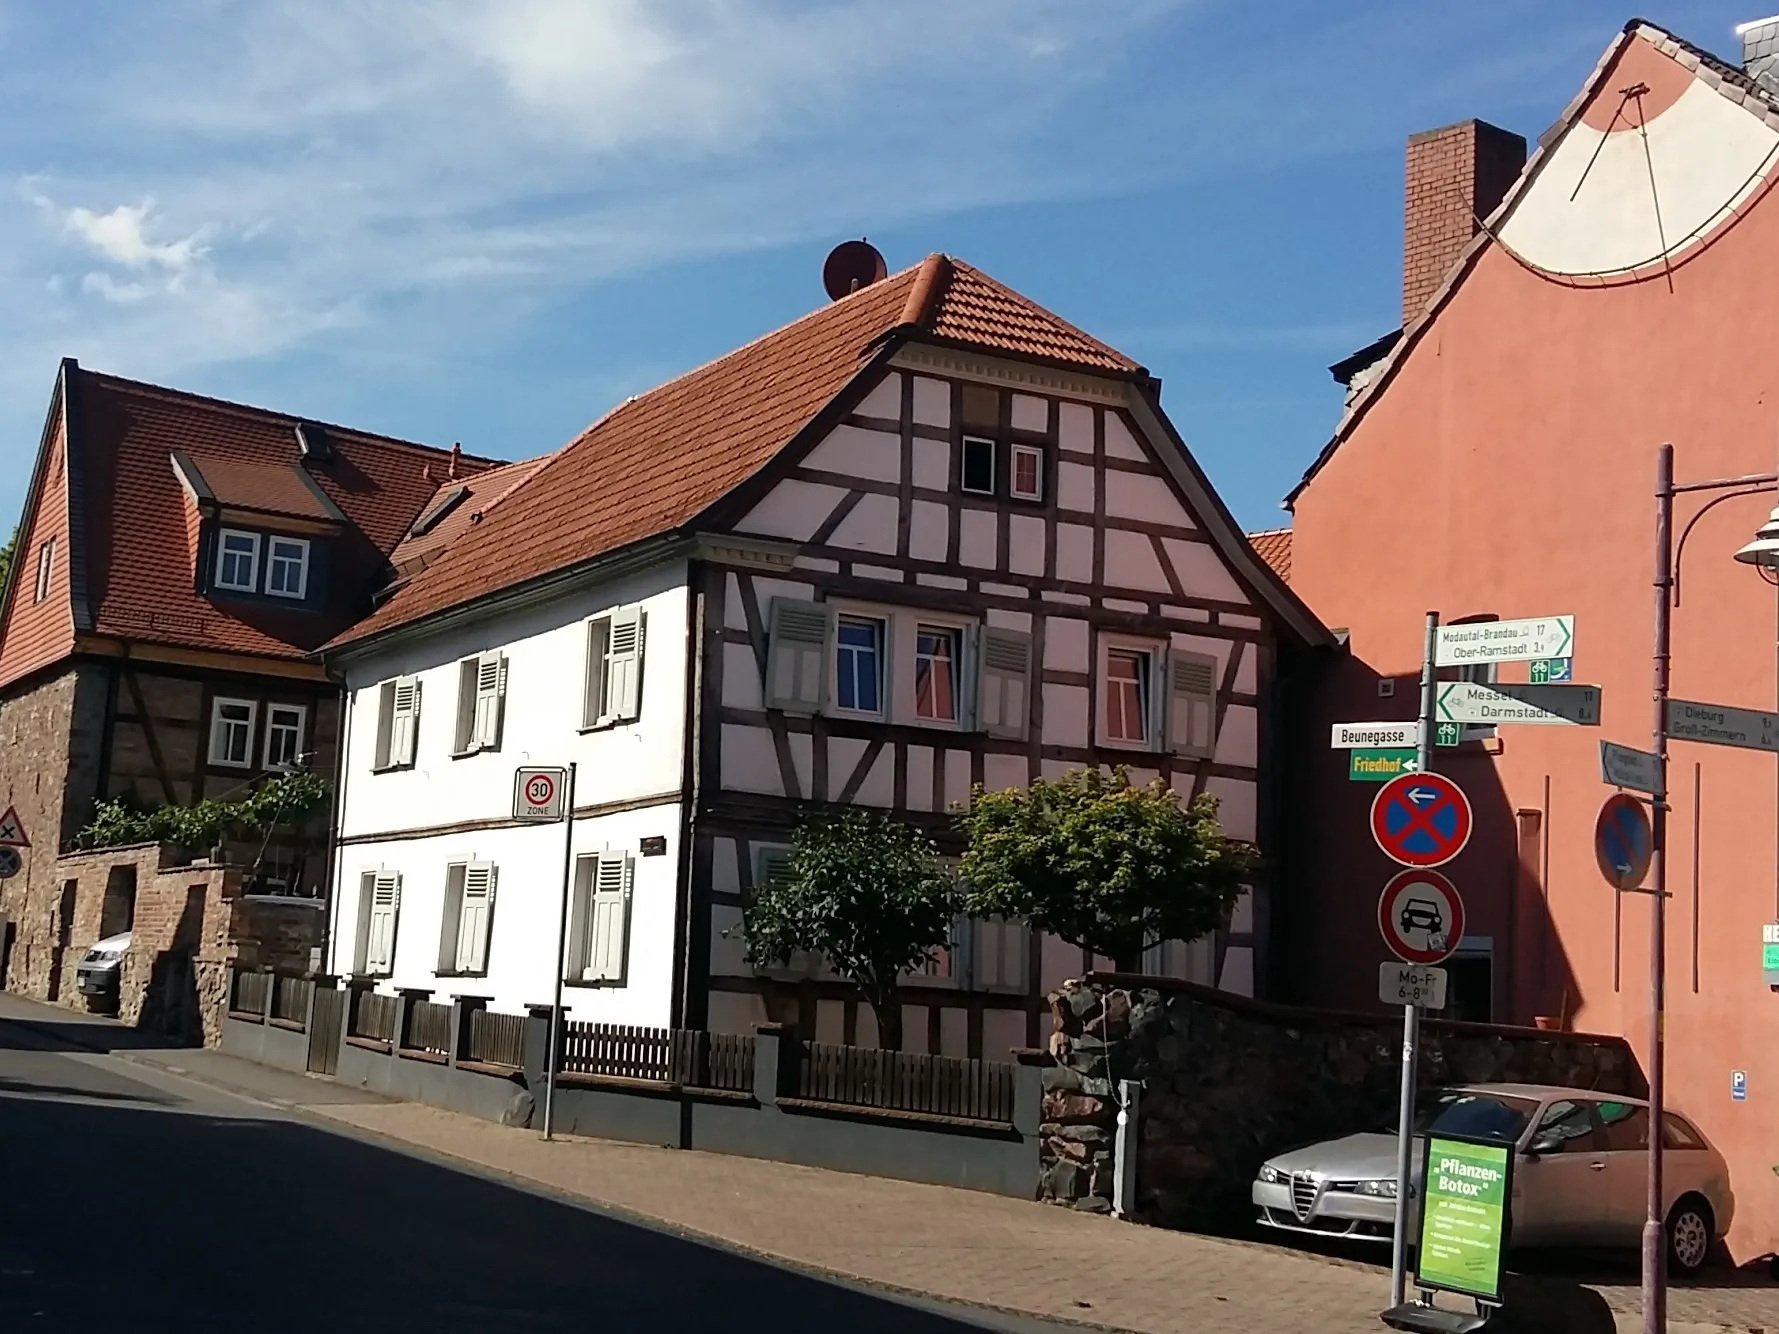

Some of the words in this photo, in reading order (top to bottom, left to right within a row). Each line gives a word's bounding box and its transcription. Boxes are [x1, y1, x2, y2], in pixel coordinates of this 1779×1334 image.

[1443, 628, 1518, 643] Modautal-Brandau
[1537, 625, 1545, 636] 17
[1454, 644, 1527, 659] Ober-Ramstadt
[1535, 673, 1544, 682] 11
[1467, 689, 1512, 701] Messel
[1481, 706, 1549, 718] Darmstadt
[1686, 706, 1724, 725] Dieburg
[1341, 729, 1404, 746] Beunegasse
[1674, 721, 1746, 741] Groß-Zimmern
[1441, 734, 1451, 744] 11
[1354, 757, 1402, 772] Friedhof
[531, 783, 548, 797] 30
[527, 806, 550, 815] ZONE
[1734, 1072, 1744, 1087] P
